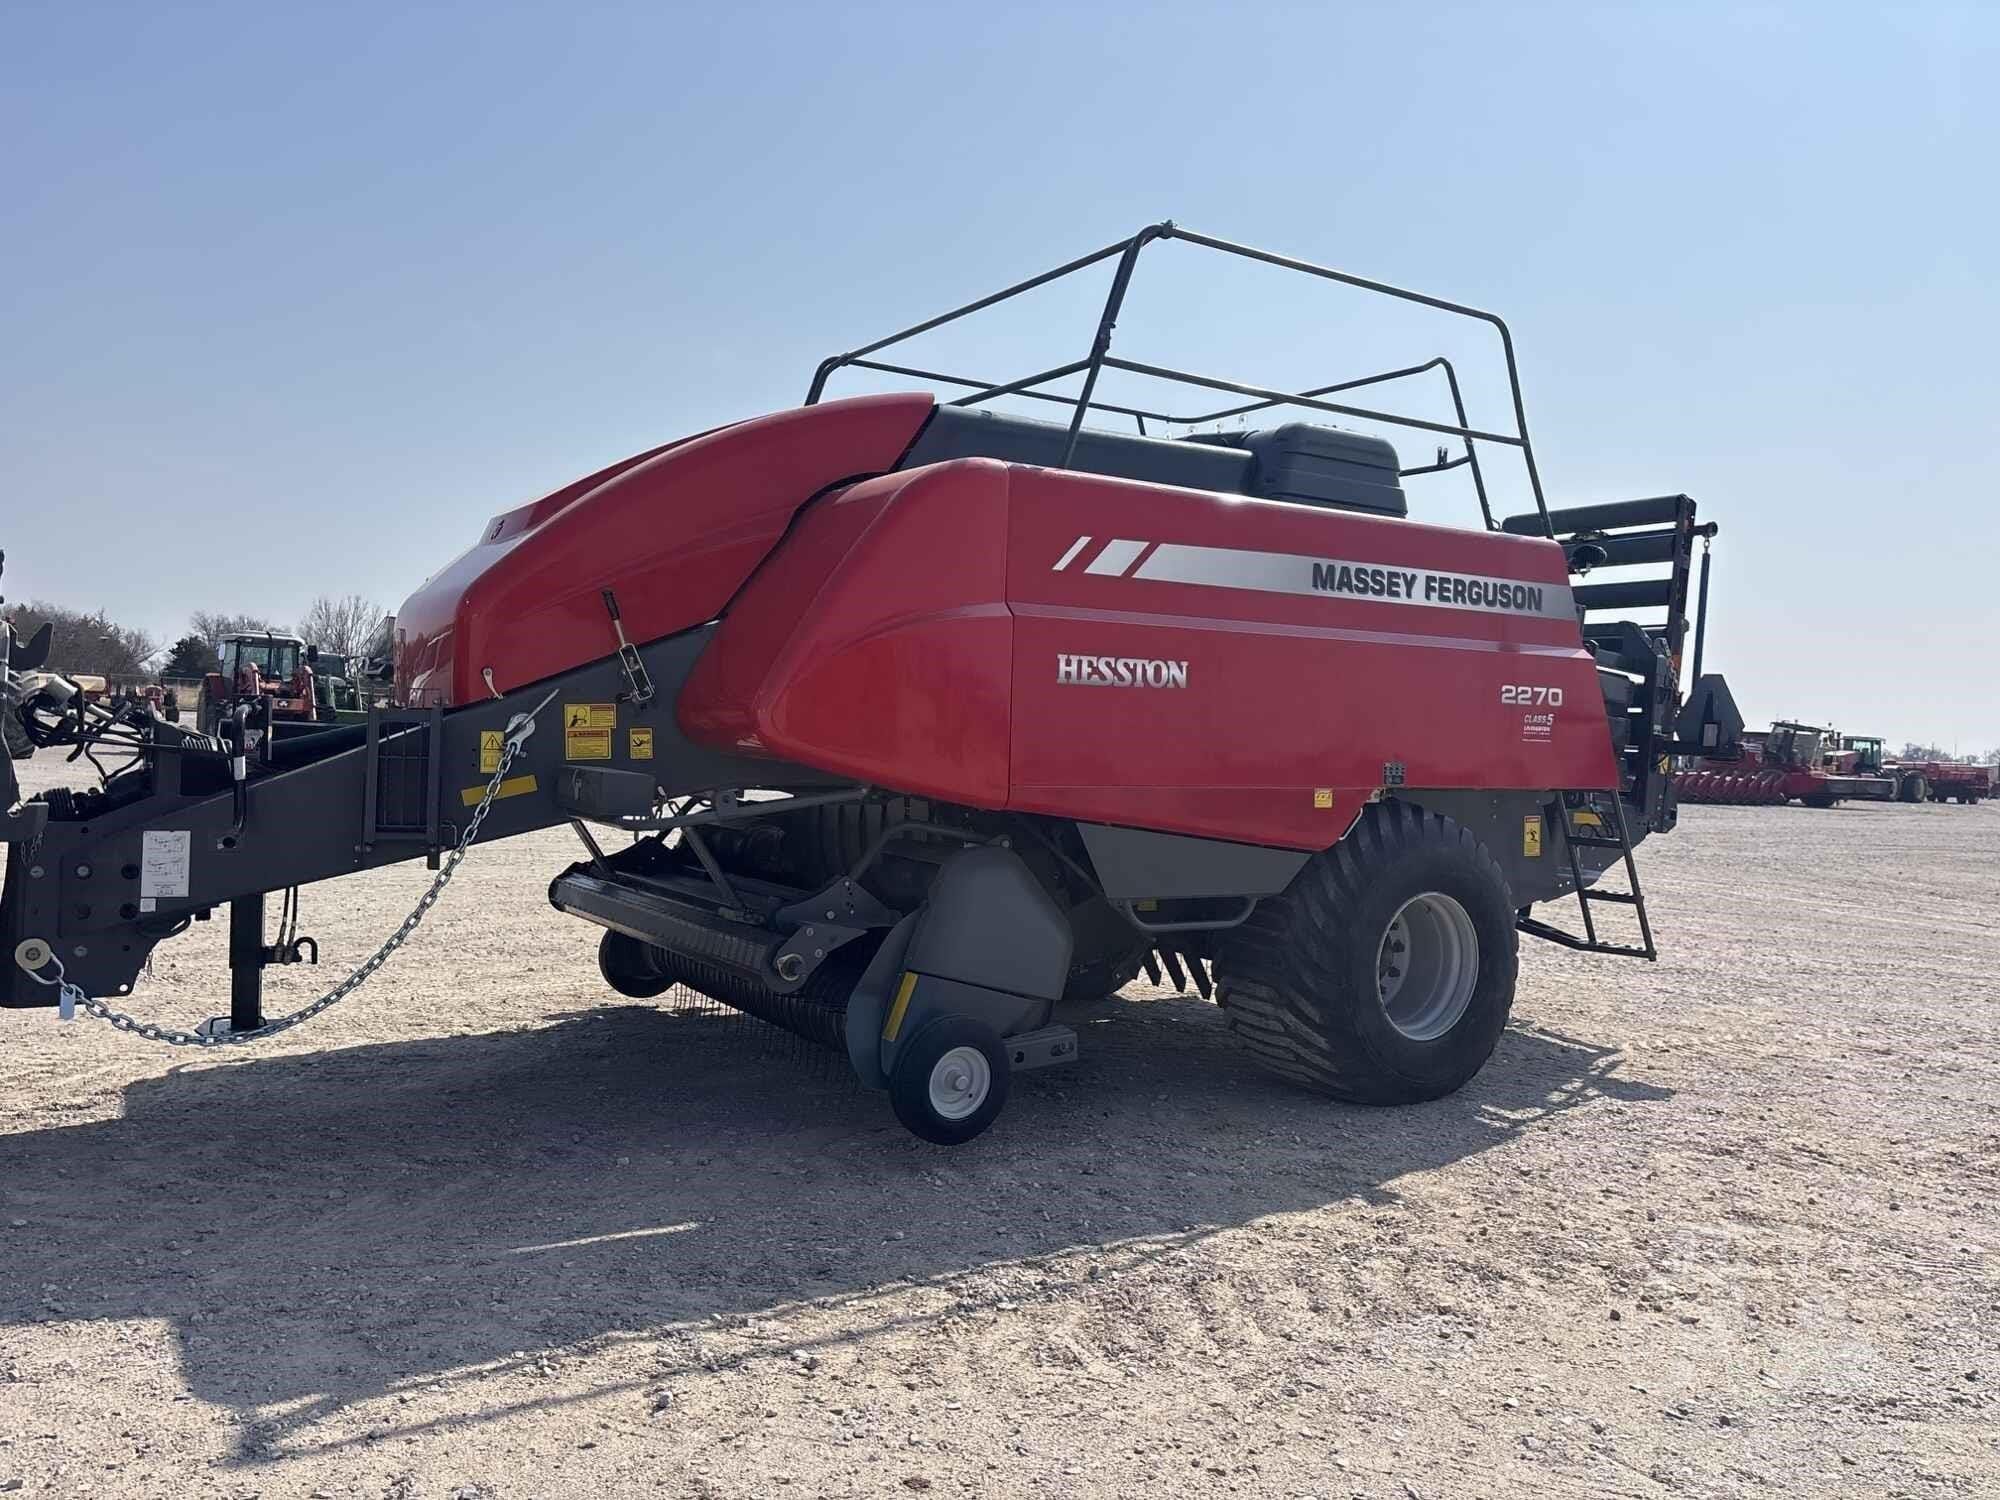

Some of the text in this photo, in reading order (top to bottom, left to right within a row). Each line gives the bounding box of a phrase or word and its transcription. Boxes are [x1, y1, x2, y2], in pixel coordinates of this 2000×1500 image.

[1312, 562, 1543, 611] MASSEY FERGUSON
[1056, 653, 1189, 688] HESSTON
[1501, 684, 1563, 706] 2270
